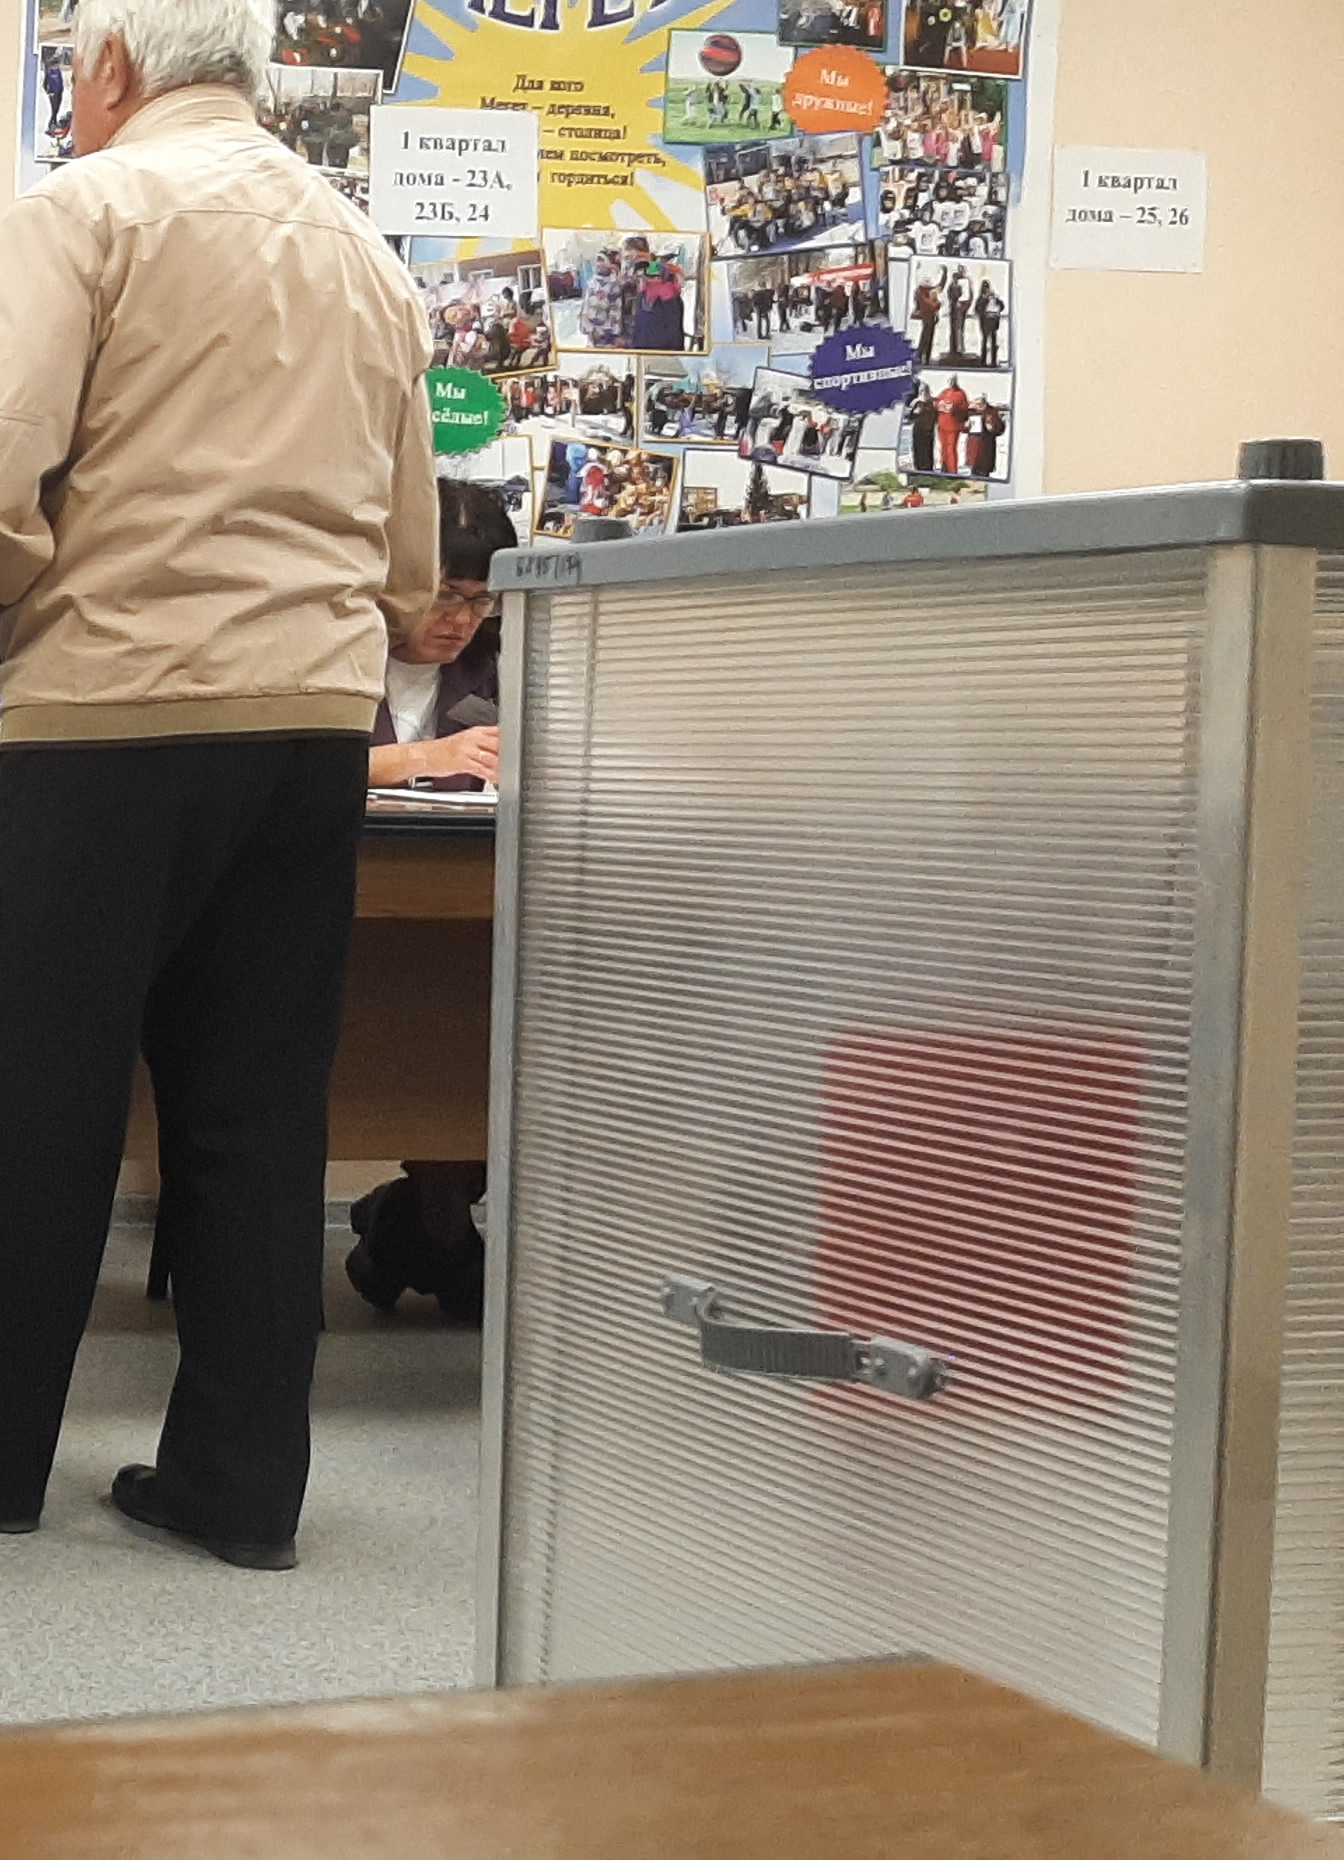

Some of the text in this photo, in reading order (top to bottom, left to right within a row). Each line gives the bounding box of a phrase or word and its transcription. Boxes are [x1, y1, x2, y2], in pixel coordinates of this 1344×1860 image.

[513, 74, 584, 93] Для кого
[820, 69, 850, 87] Мы
[547, 103, 615, 119] деревня,
[793, 92, 873, 116] дружные!
[558, 125, 627, 140] столица!
[401, 130, 507, 156] 1 квартал
[569, 150, 667, 167] посмотреть,
[393, 172, 445, 187] дома
[466, 169, 512, 191] 23А,
[550, 171, 634, 187] гордиться!
[1083, 170, 1178, 194] 1 квартал
[415, 202, 490, 222] 23Б, 24
[1065, 209, 1114, 223] дома
[1136, 206, 1162, 227] 25,
[1168, 207, 1189, 225] 26
[845, 343, 875, 361] Мы
[436, 382, 467, 399] Мы
[432, 408, 489, 425] сёлые!
